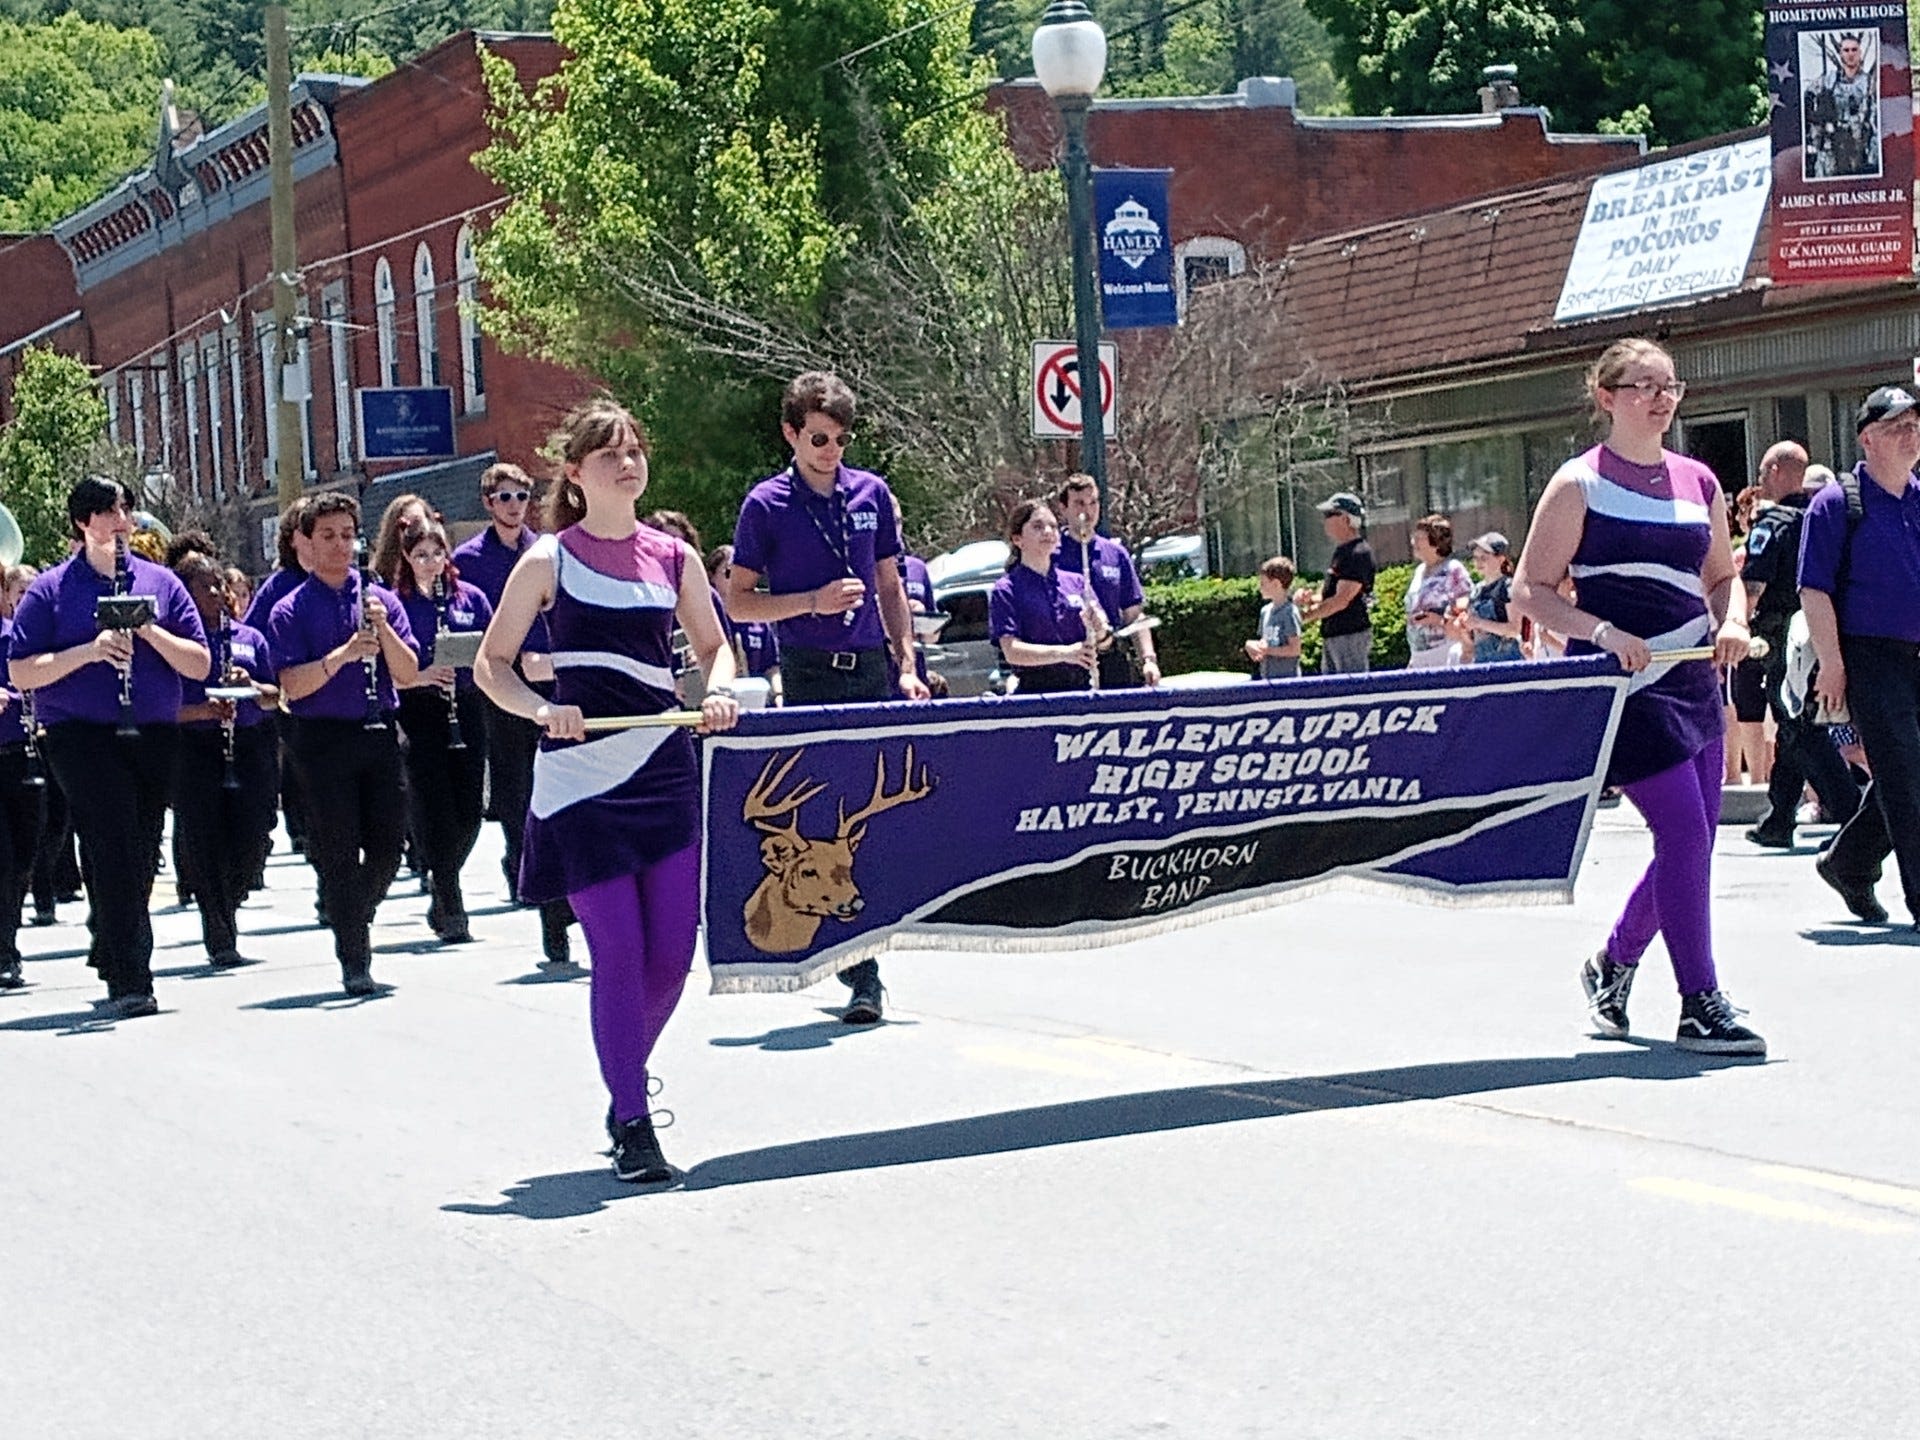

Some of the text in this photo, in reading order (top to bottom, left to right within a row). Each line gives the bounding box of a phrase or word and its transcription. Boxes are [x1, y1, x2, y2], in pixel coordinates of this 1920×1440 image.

[1769, 4, 1904, 23] HOMETOWN HEROES
[1634, 149, 1740, 190] BEST
[1589, 165, 1771, 223] BREAKFAST
[1779, 189, 1907, 209] JAMES C. STRASSER JR.
[1642, 207, 1700, 232] IN THE
[1800, 222, 1882, 235] STAFF SERGEANT
[1103, 235, 1163, 250] HAWLEY
[1607, 219, 1722, 260] POCONOS
[1801, 243, 1859, 257] NATIONAL
[1861, 241, 1901, 253] GUARD
[1628, 254, 1680, 278] DAILY
[1659, 266, 1740, 294] SPECIALS
[1054, 705, 1446, 763] WALLENPAUPACK
[1090, 745, 1370, 795] HIGH SCHOOL
[1015, 777, 1421, 833] HAWLEY, PENNSYLVANIA
[1108, 841, 1260, 881] BUCKHORN
[1141, 875, 1212, 910] BAND
